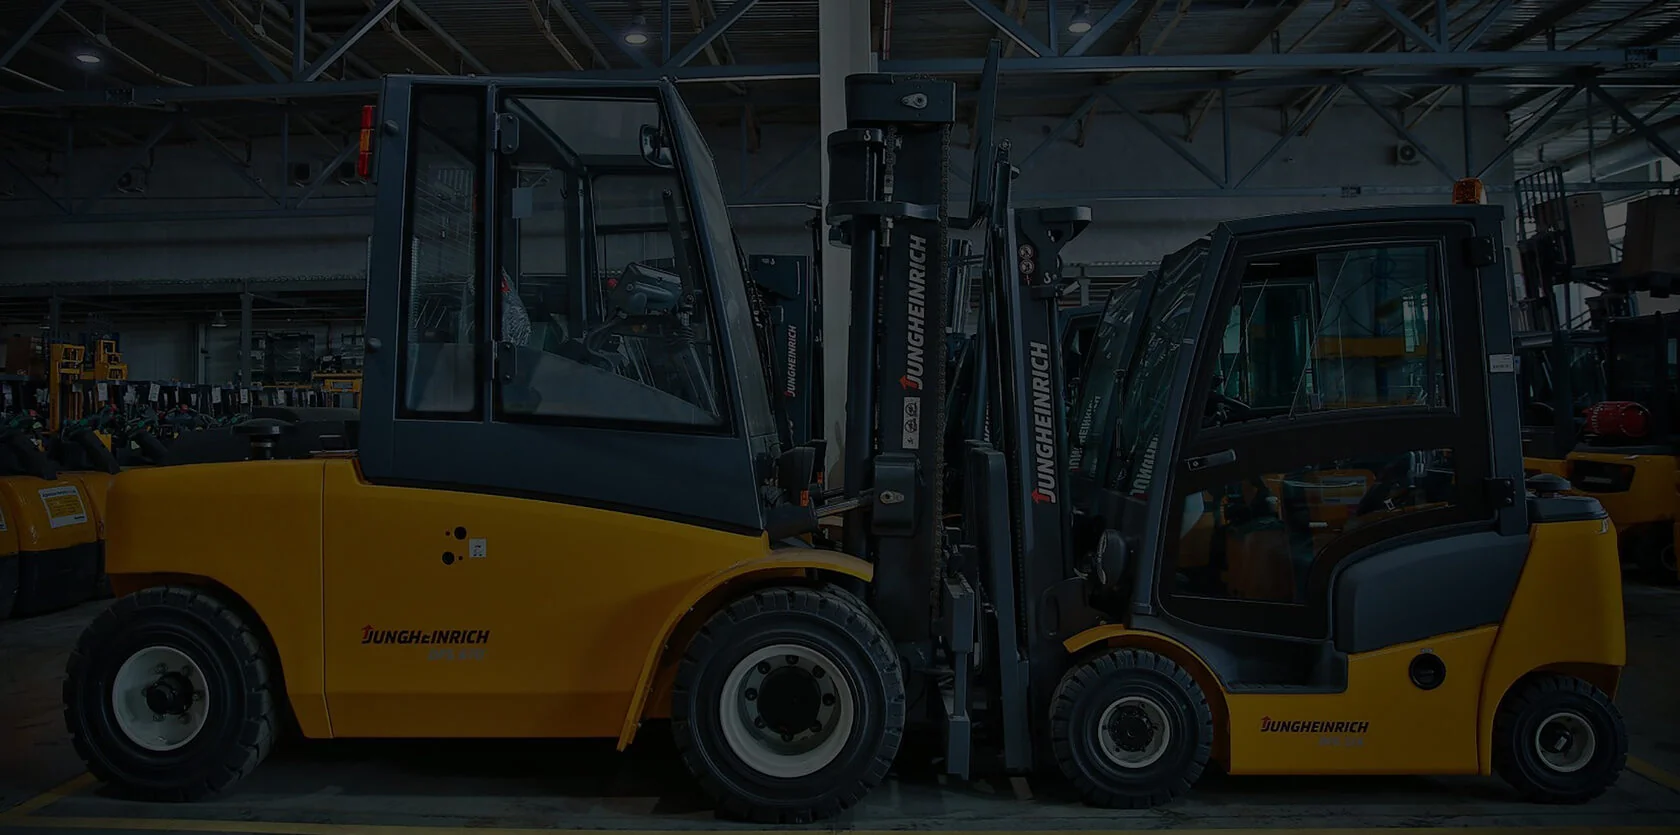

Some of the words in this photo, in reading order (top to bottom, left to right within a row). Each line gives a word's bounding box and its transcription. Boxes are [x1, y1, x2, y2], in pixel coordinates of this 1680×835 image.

[904, 234, 927, 390] JUNGHEINRICH
[785, 325, 797, 398] JUNGHEINRICH
[1029, 341, 1056, 504] JUNGHEINRICH
[361, 627, 490, 644] JUNGHEINRICH
[1260, 719, 1369, 733] JUNGHEINRICH
